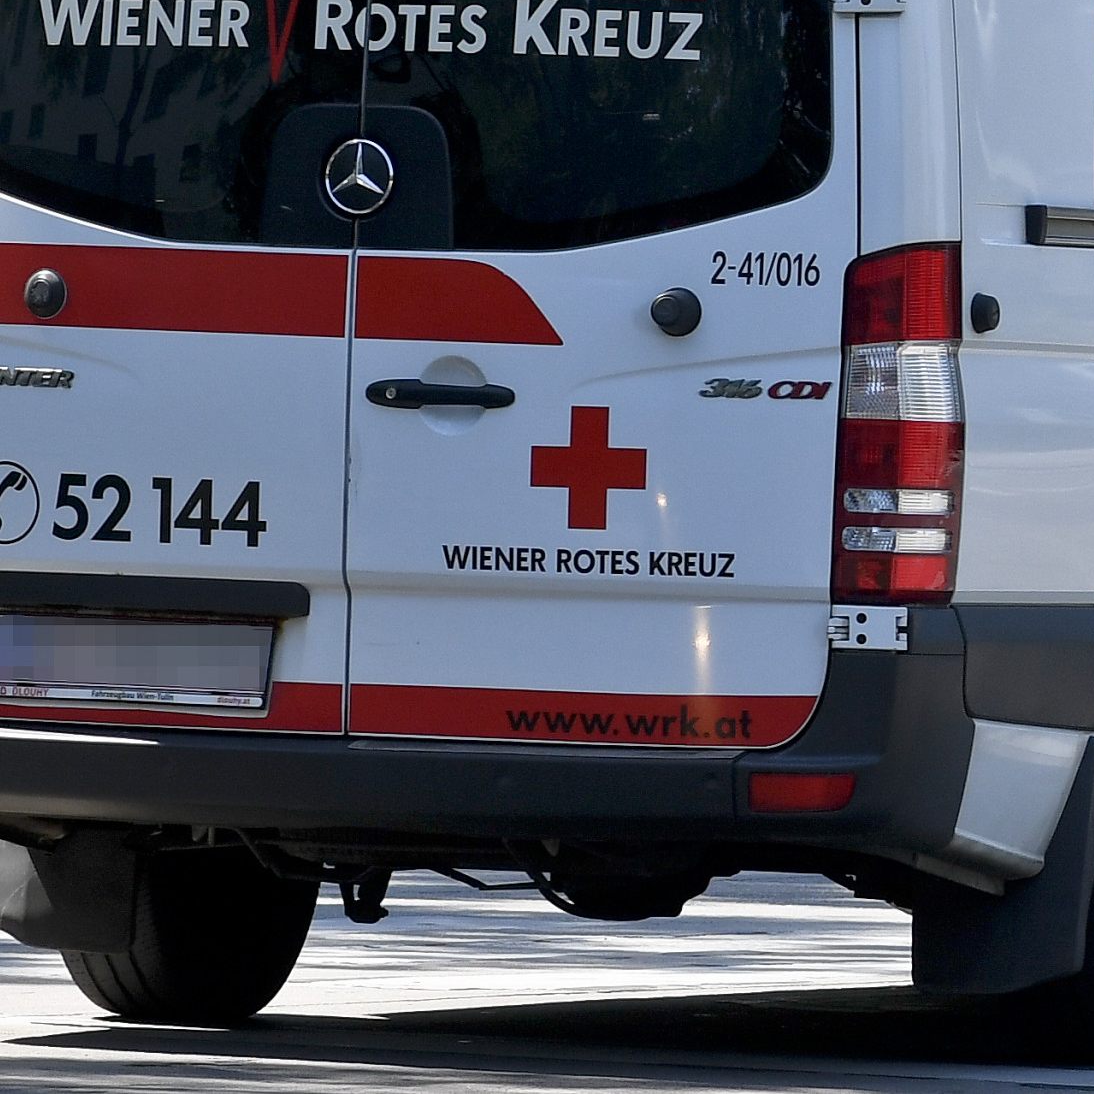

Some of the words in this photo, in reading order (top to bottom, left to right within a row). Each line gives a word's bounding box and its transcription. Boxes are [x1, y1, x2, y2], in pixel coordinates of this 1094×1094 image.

[711, 251, 820, 286] 2-41/016
[699, 378, 763, 399] 316
[767, 380, 832, 399] CDI
[52, 473, 131, 541] 52
[152, 477, 267, 548] 144
[442, 544, 546, 572] WIENER
[556, 549, 640, 575] ROTES
[649, 551, 735, 577] KREUZ
[507, 705, 753, 739] www.wrk.at
